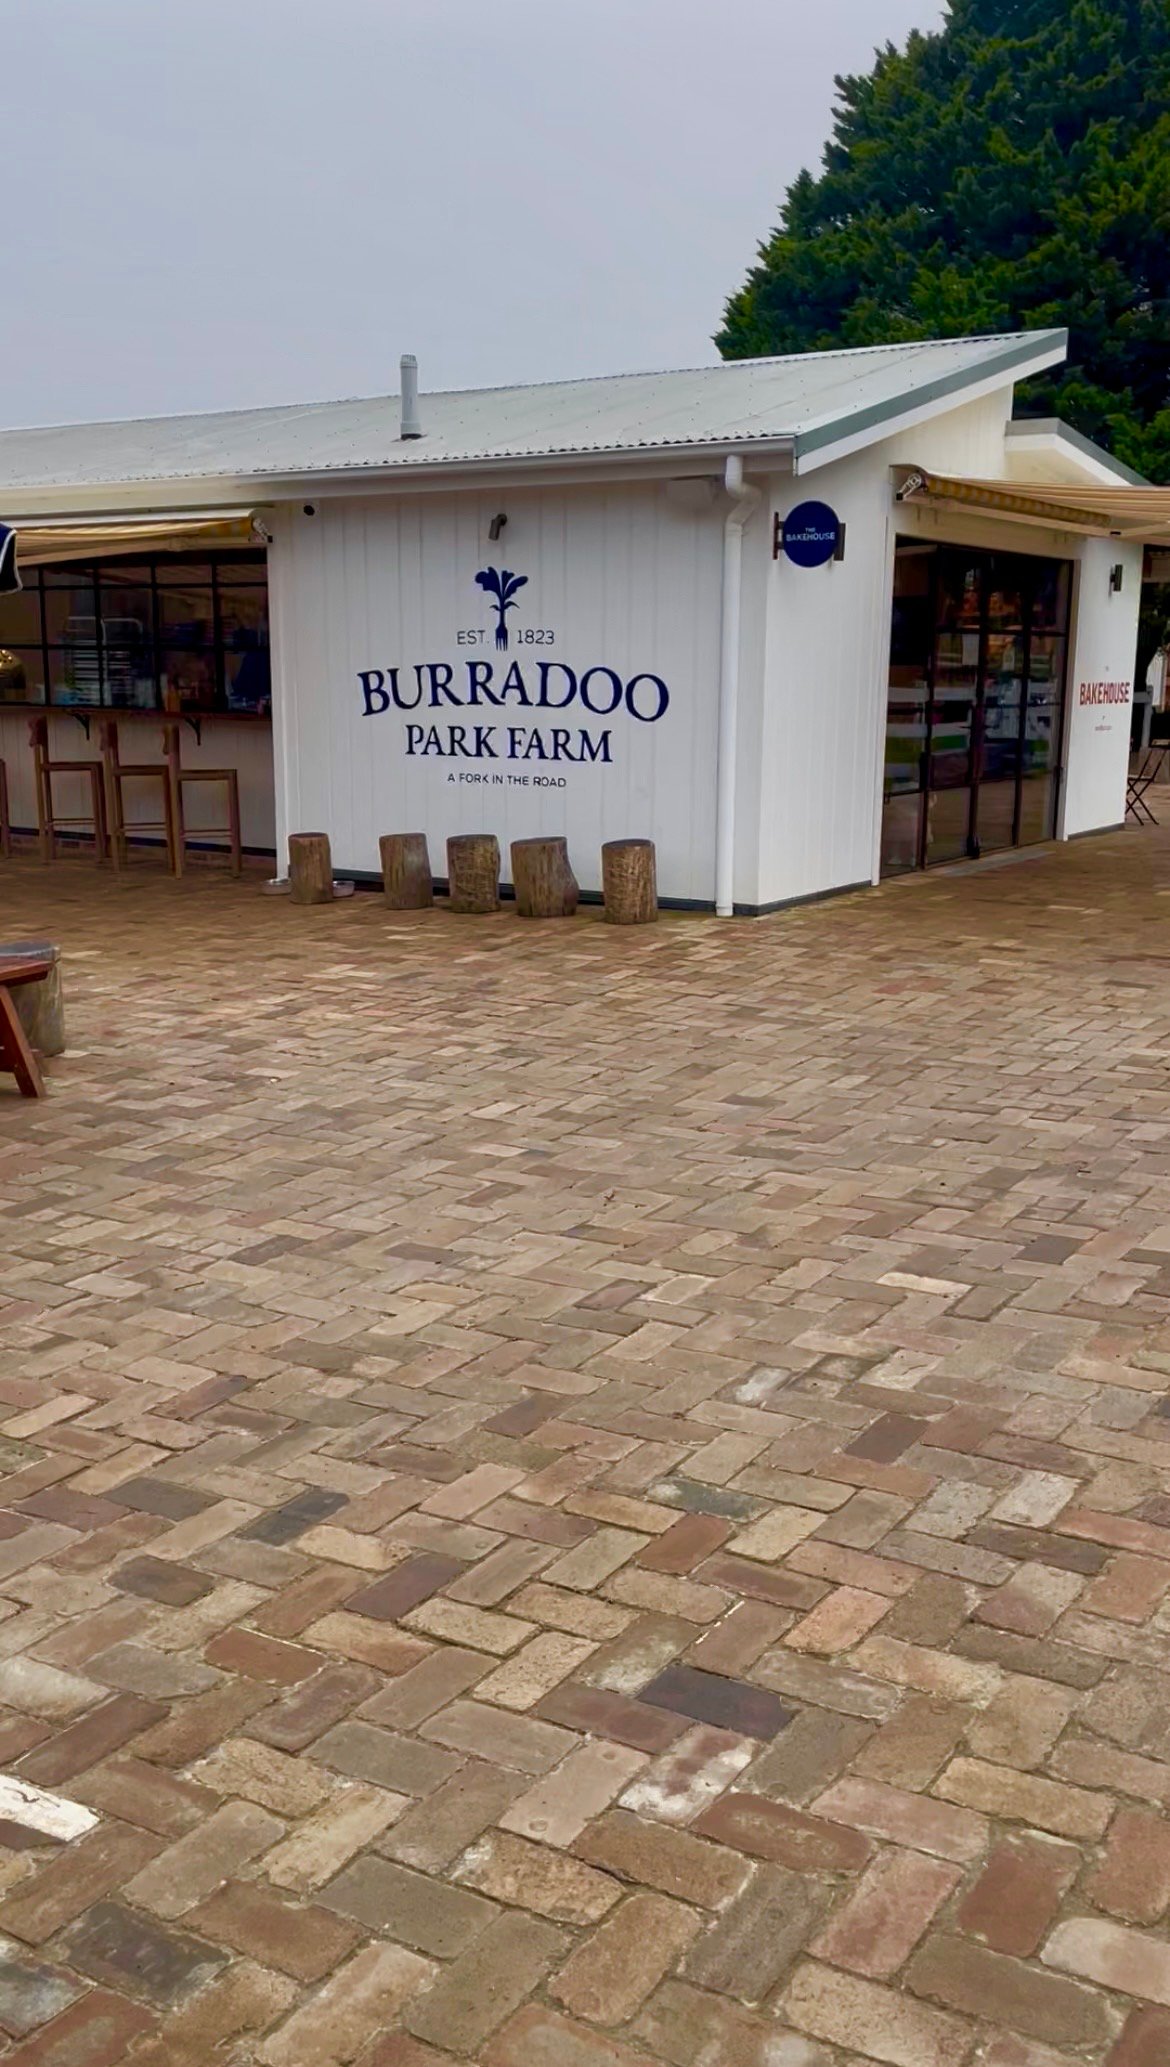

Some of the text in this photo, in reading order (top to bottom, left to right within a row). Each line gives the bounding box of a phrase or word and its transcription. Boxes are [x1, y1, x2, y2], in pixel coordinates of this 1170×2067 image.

[786, 532, 835, 541] BAKEHOUSE
[457, 630, 555, 645] EST. 1823
[357, 661, 669, 722] BURRADOO
[1080, 682, 1130, 705] BAKEHOUSE
[405, 724, 613, 762] PARK FARM
[447, 773, 567, 788] A FORK IN THE ROAD
